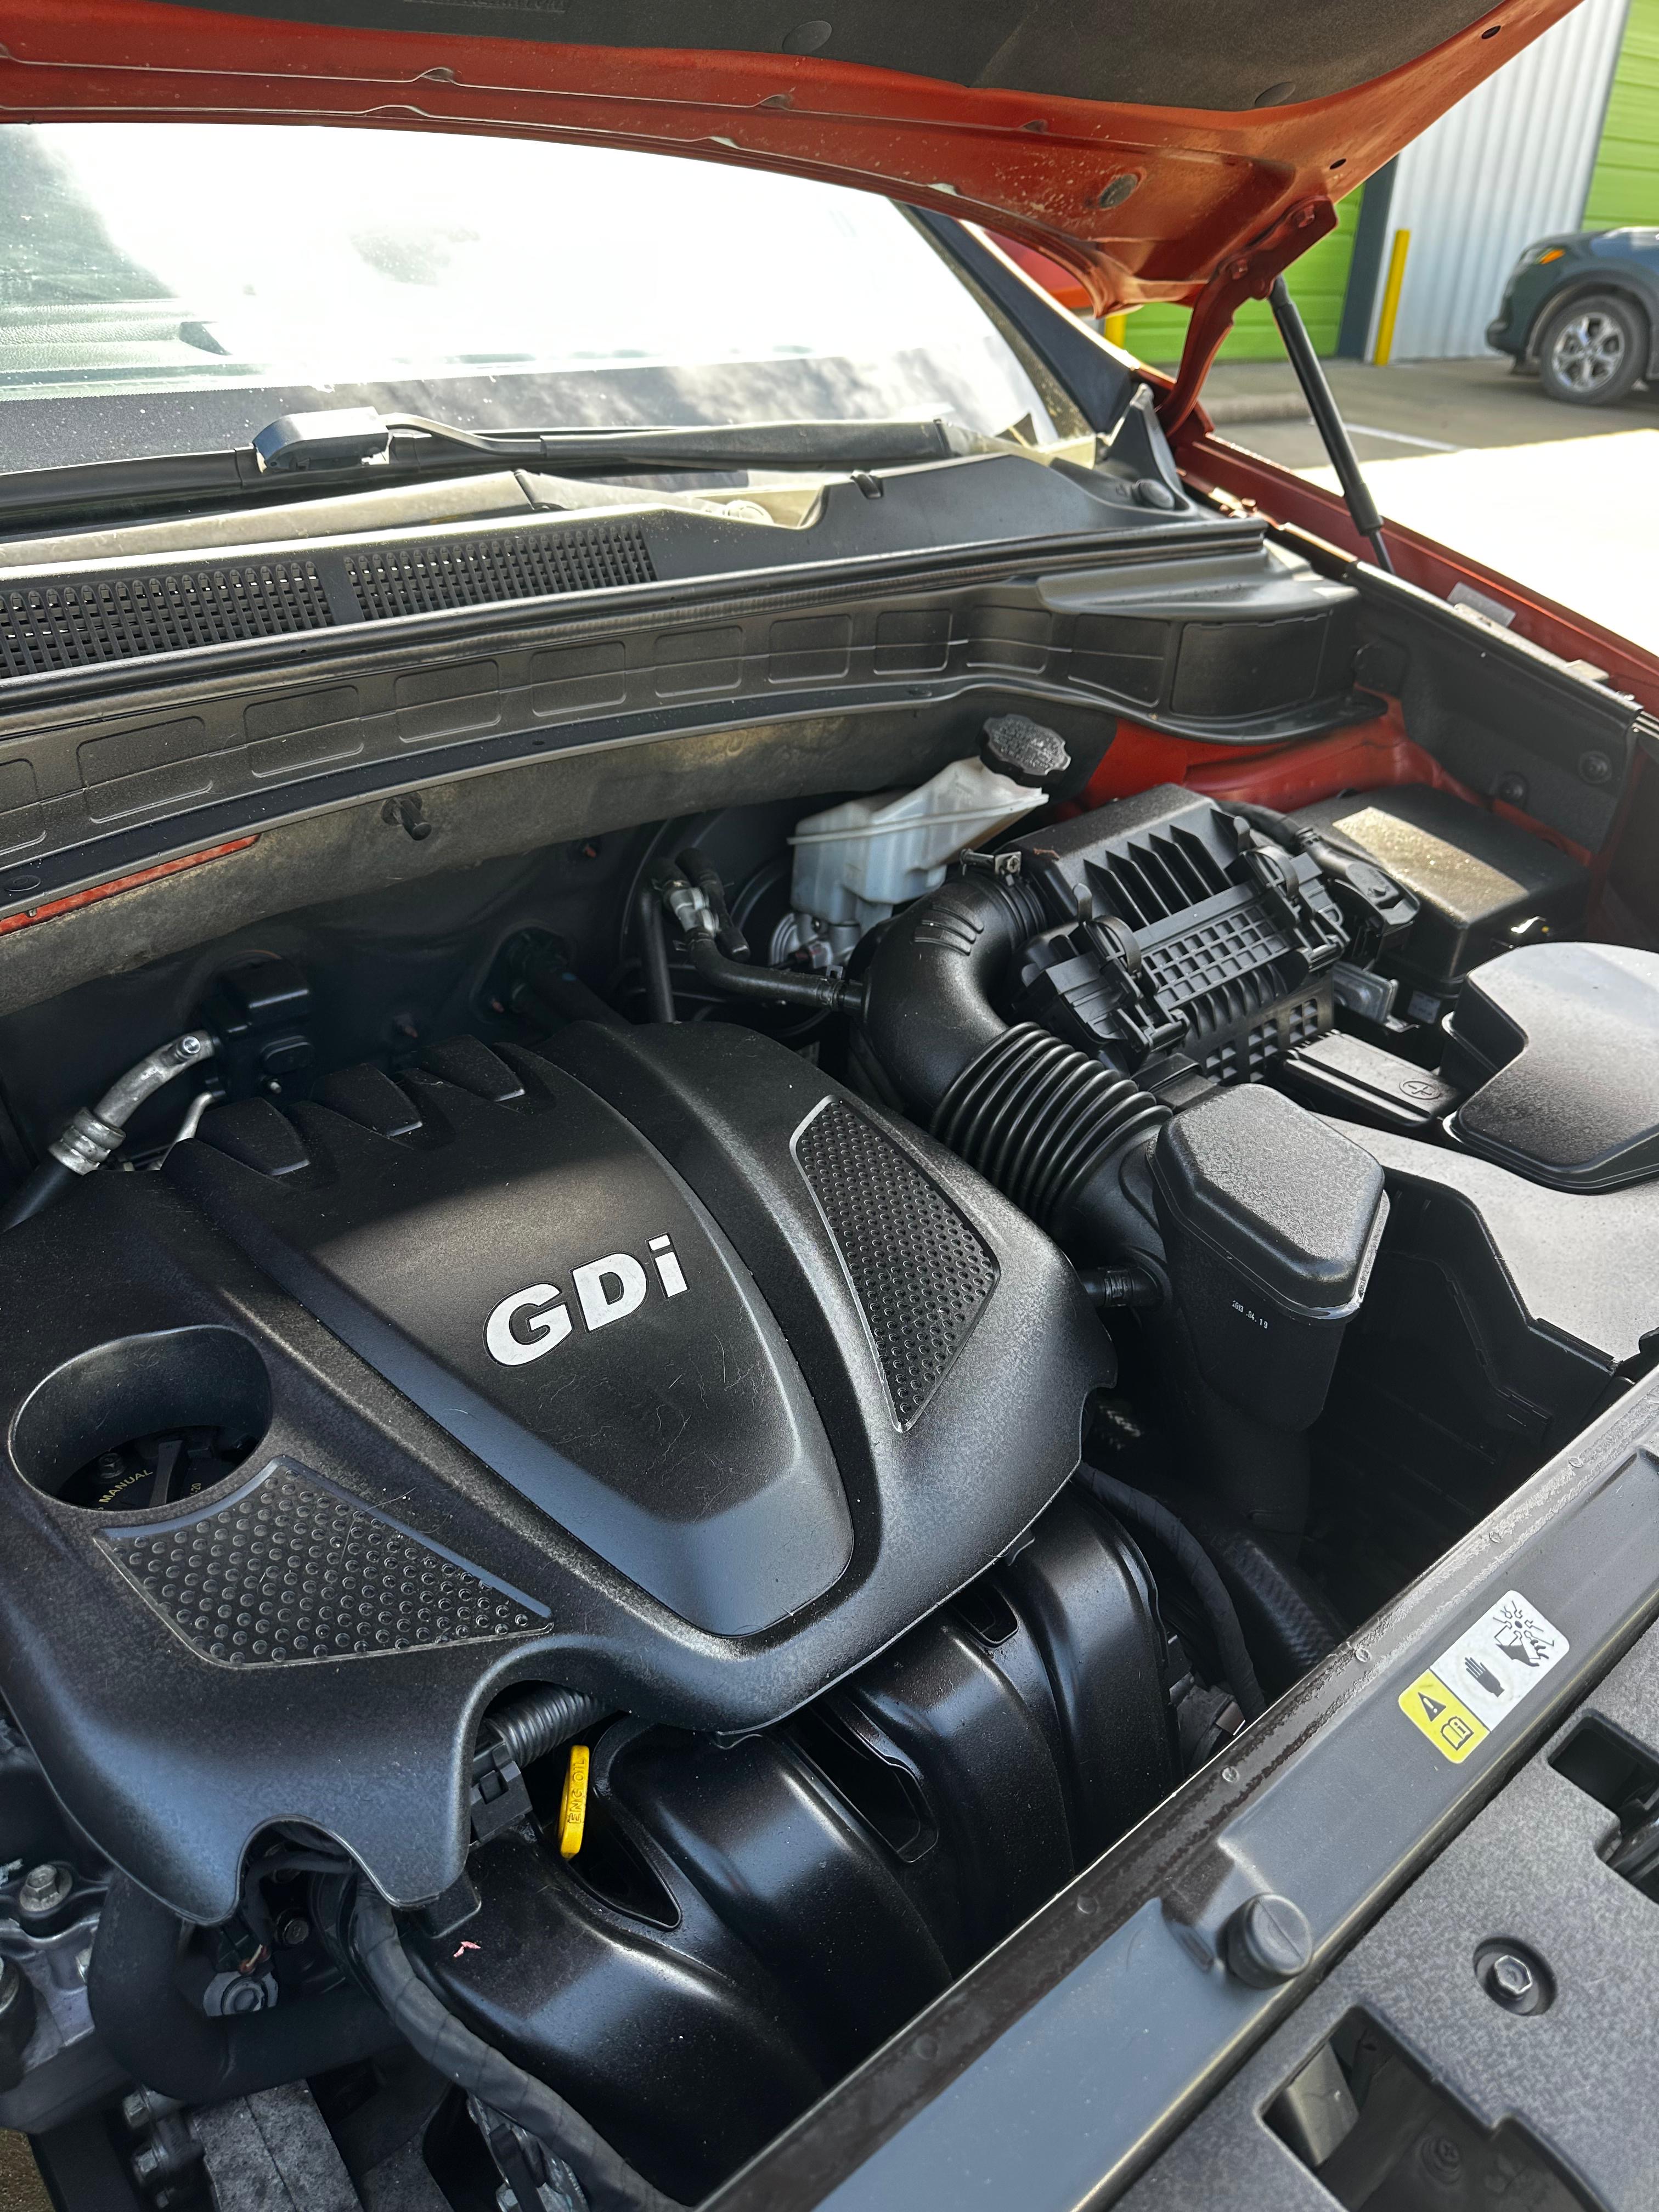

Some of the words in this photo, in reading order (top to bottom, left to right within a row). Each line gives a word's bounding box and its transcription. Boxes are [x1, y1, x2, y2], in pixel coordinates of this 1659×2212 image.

[486, 1234, 689, 1366] GDi
[98, 1469, 154, 1503] MANUAL
[573, 1759, 585, 1781] OIL
[568, 1789, 583, 1824] ENG
